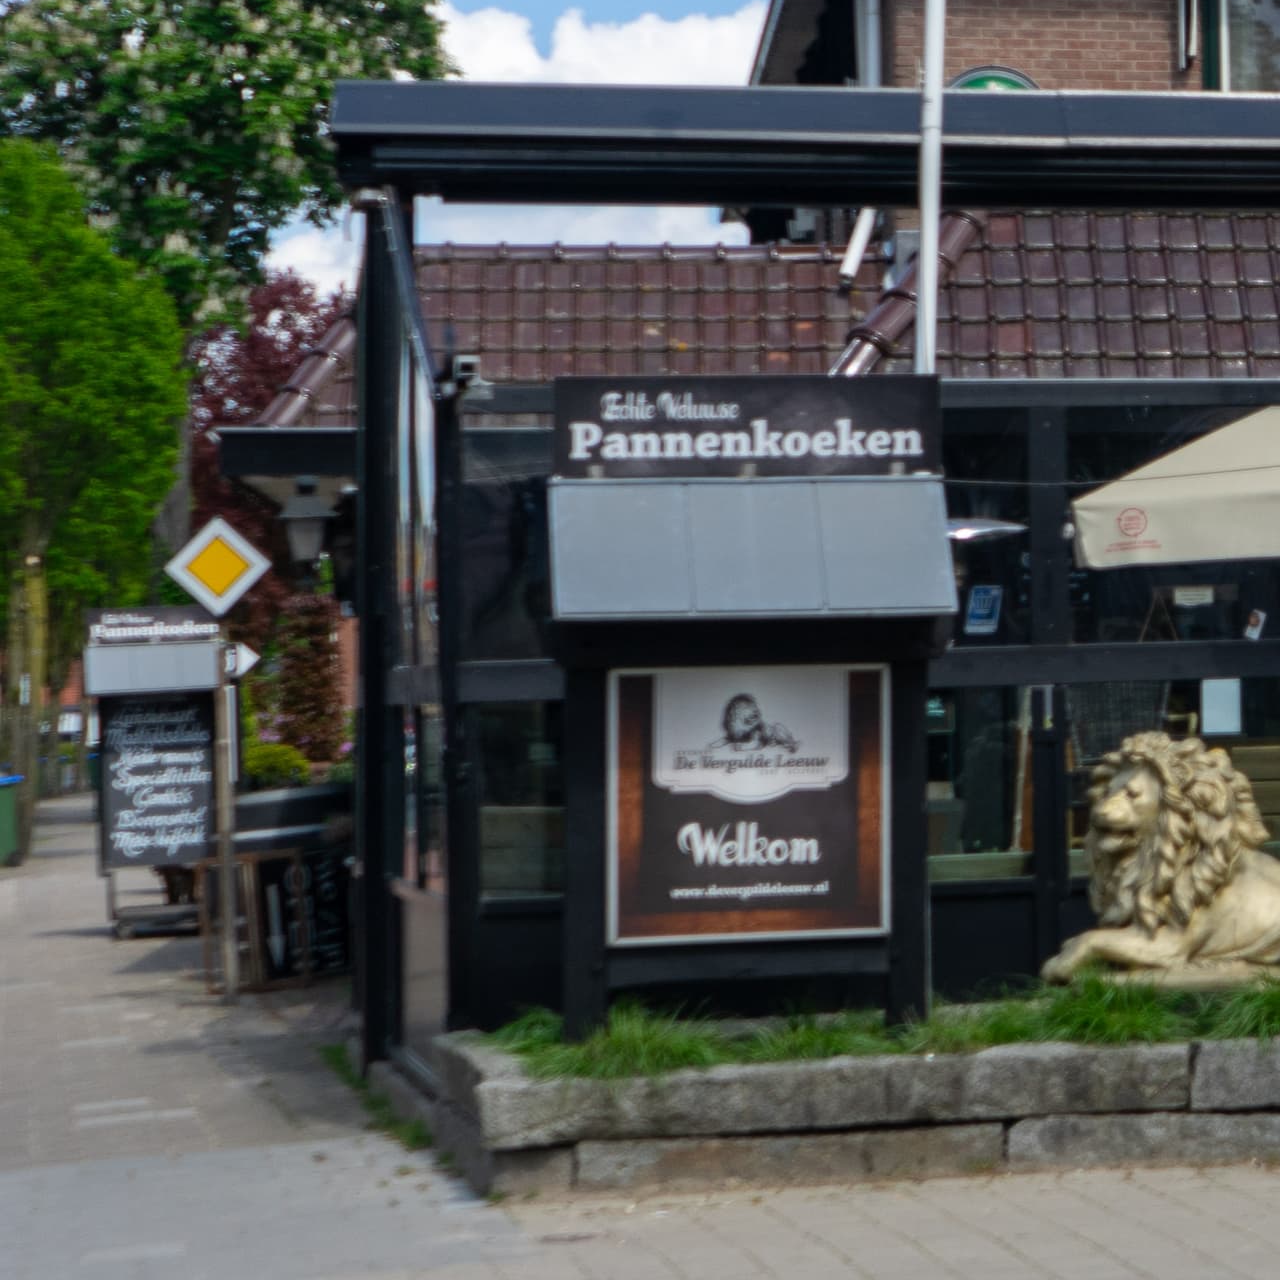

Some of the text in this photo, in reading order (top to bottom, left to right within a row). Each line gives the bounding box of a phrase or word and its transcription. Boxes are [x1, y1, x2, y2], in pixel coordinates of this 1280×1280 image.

[569, 418, 923, 459] Pannenkoeken
[674, 756, 696, 770] De
[702, 754, 771, 773] Vergulde
[775, 754, 829, 768] Leeuw
[677, 822, 821, 865] Welkom
